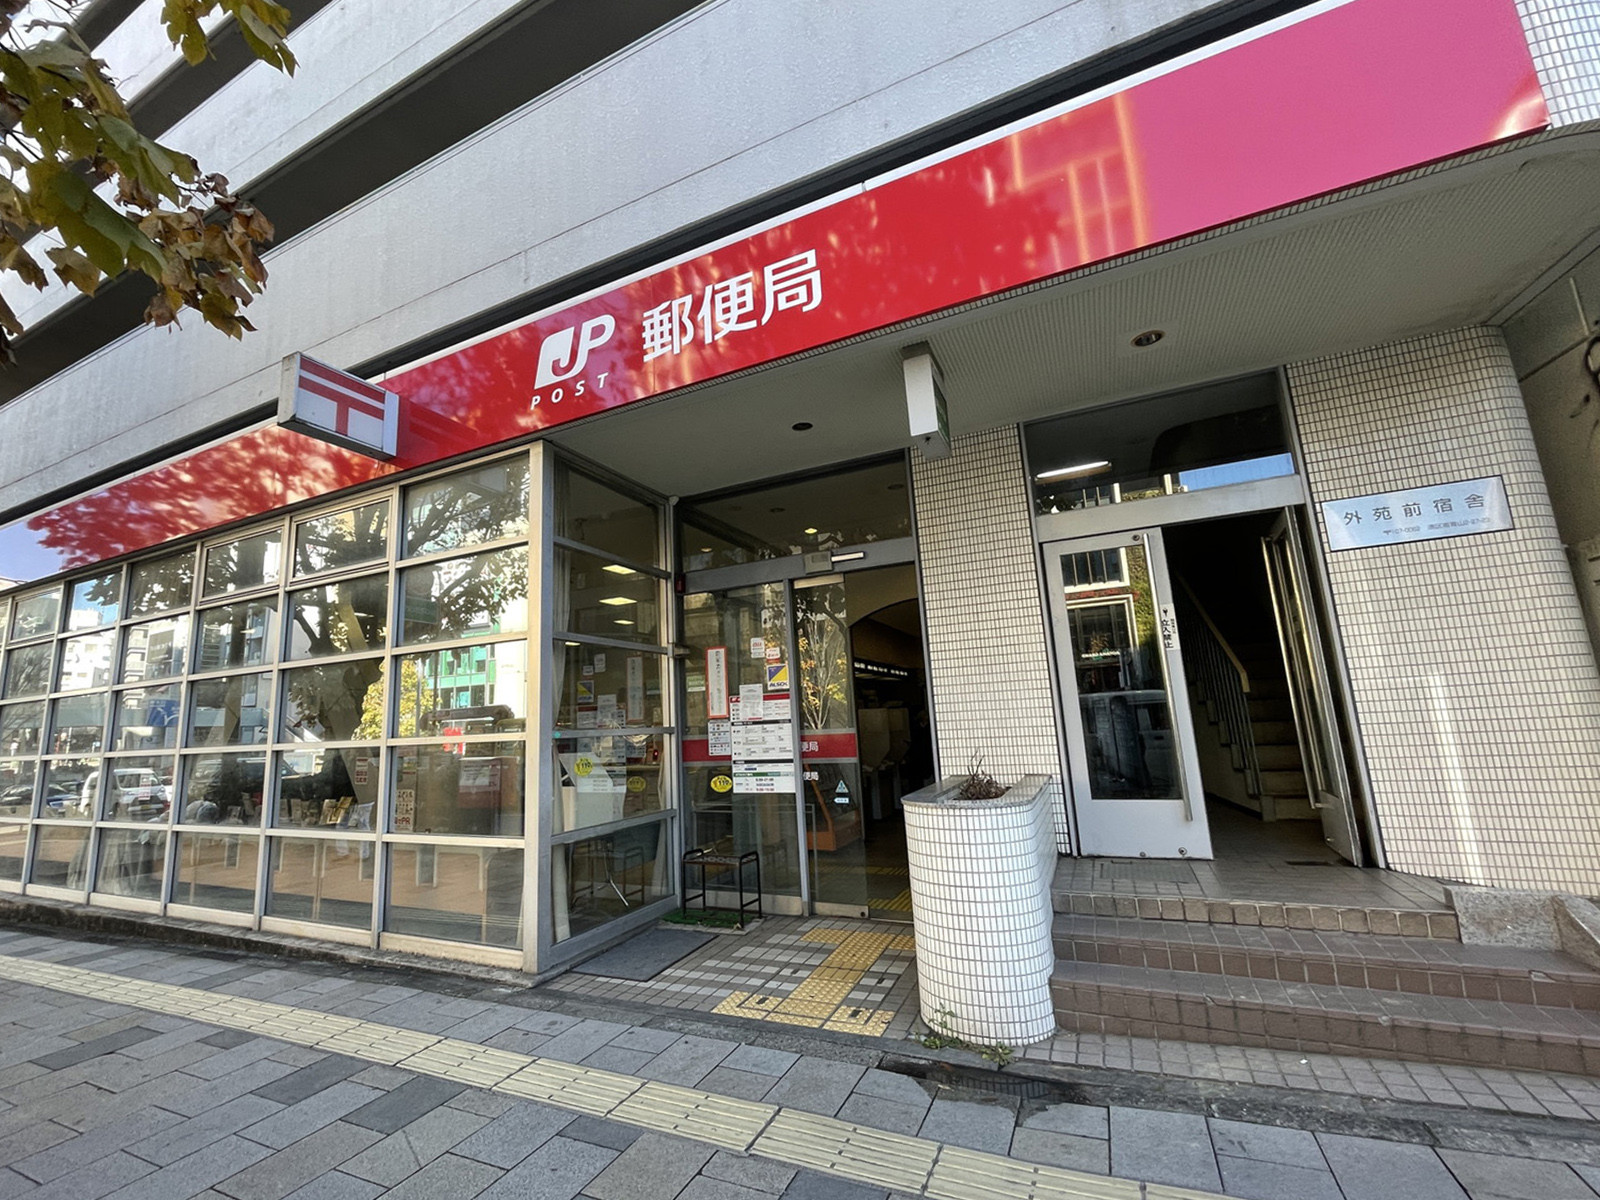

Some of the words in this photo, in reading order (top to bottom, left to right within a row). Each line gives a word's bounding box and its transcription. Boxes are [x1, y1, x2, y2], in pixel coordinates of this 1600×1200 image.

[641, 249, 823, 362] 郵便局
[530, 372, 609, 410] POST
[1343, 493, 1485, 526] 外苑前宿舎
